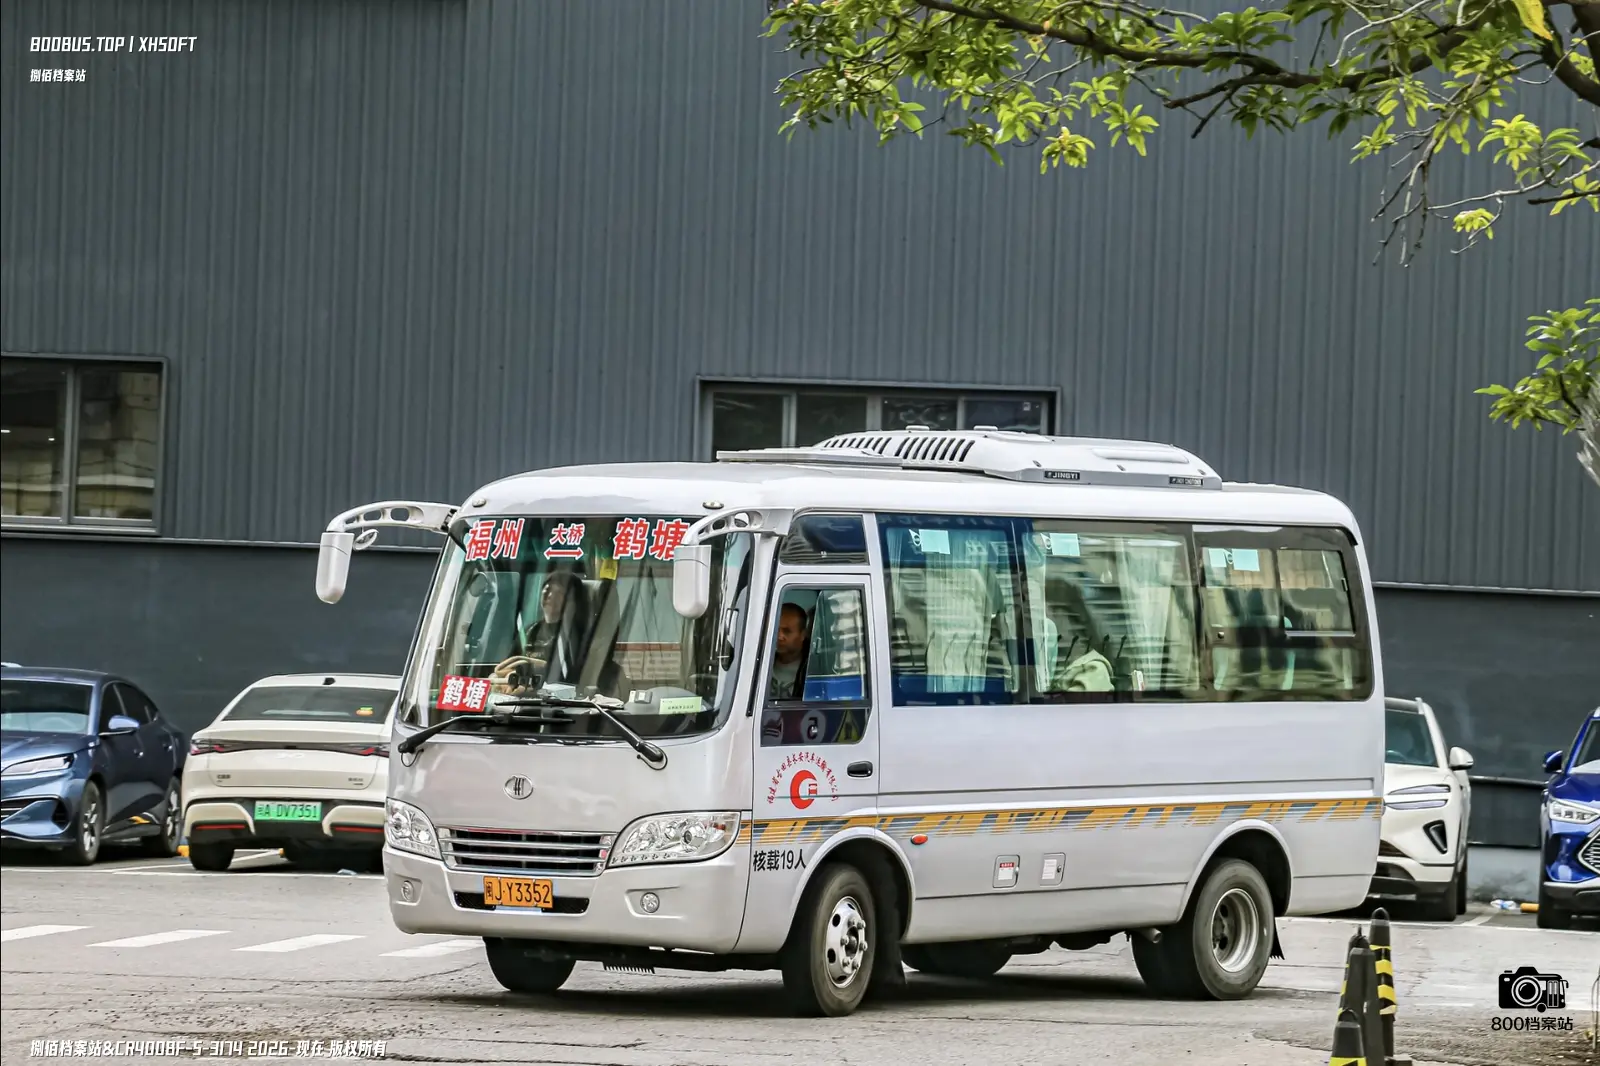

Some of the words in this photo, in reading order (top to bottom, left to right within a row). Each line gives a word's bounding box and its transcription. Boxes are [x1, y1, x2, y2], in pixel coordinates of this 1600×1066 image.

[465, 519, 525, 561] 福州
[550, 524, 584, 546] 大桥
[613, 518, 690, 561] 鹤塘
[442, 676, 486, 710] 鹤塘
[753, 849, 806, 872] 核载19人
